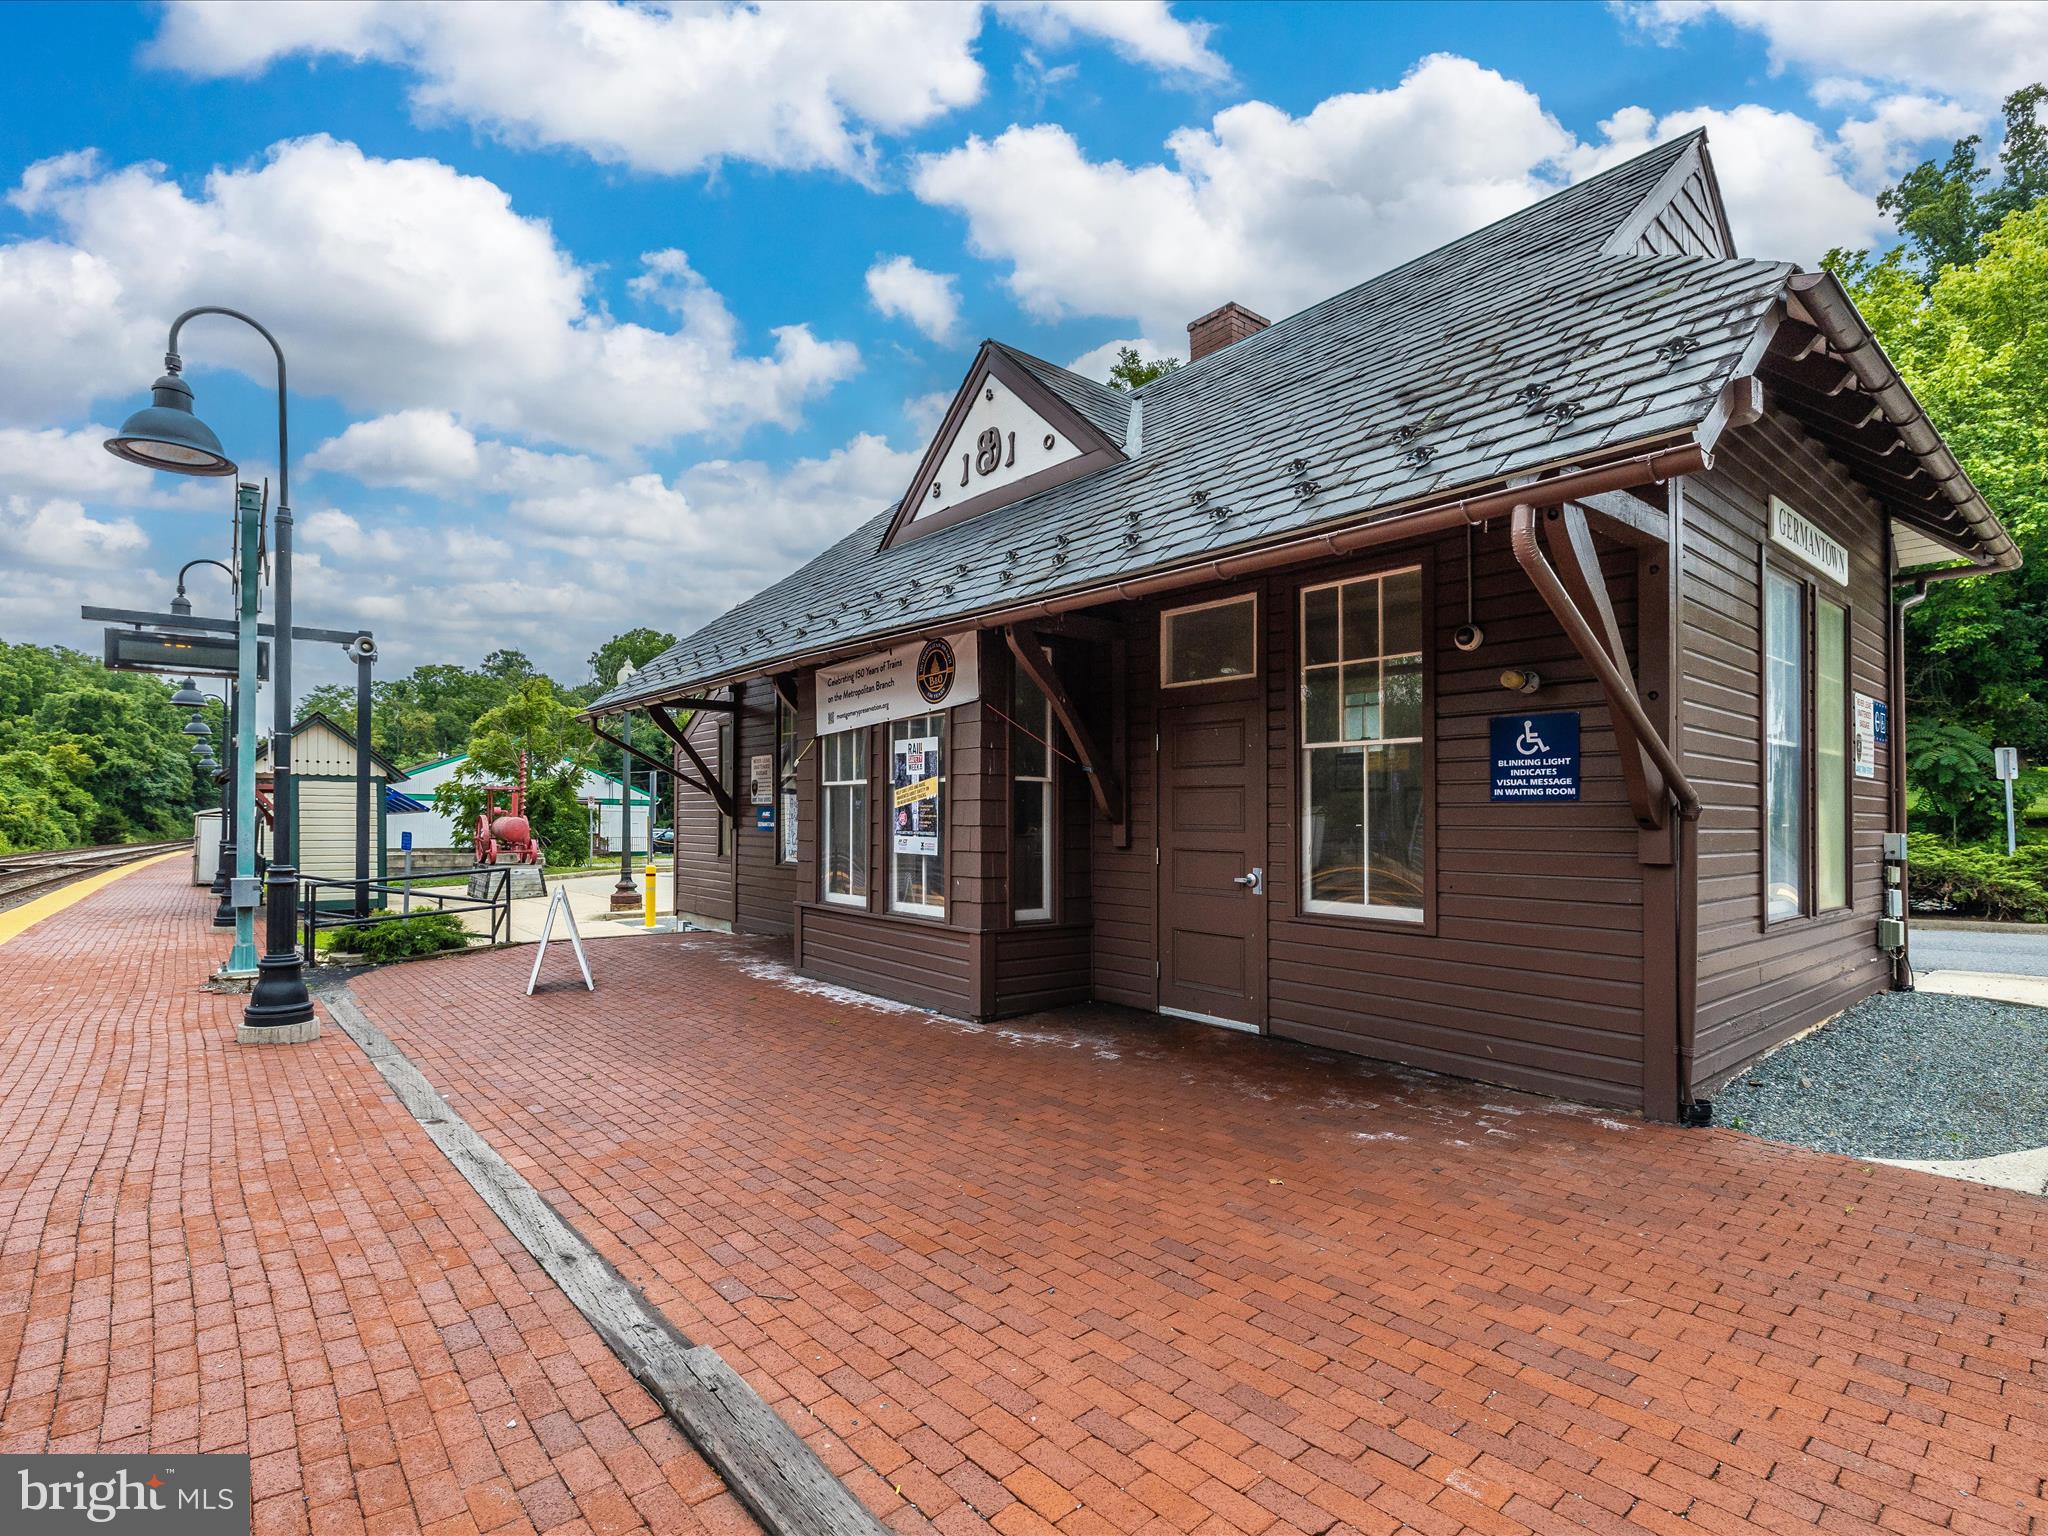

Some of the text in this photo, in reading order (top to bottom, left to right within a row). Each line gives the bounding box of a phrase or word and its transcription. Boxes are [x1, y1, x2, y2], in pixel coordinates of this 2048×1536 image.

[1778, 507, 1845, 575] GERMANTOWN
[827, 658, 903, 687] Celebrating 150 Years of Trains
[827, 677, 895, 704] on the Metropolitan Branch
[907, 742, 923, 755] RAIL
[1498, 757, 1571, 767] BLINKING LIGHT
[1510, 768, 1557, 776] INDICATES
[1496, 777, 1573, 786] VISUAL MESSAGE
[1494, 787, 1576, 796] IN WAITING ROOM
